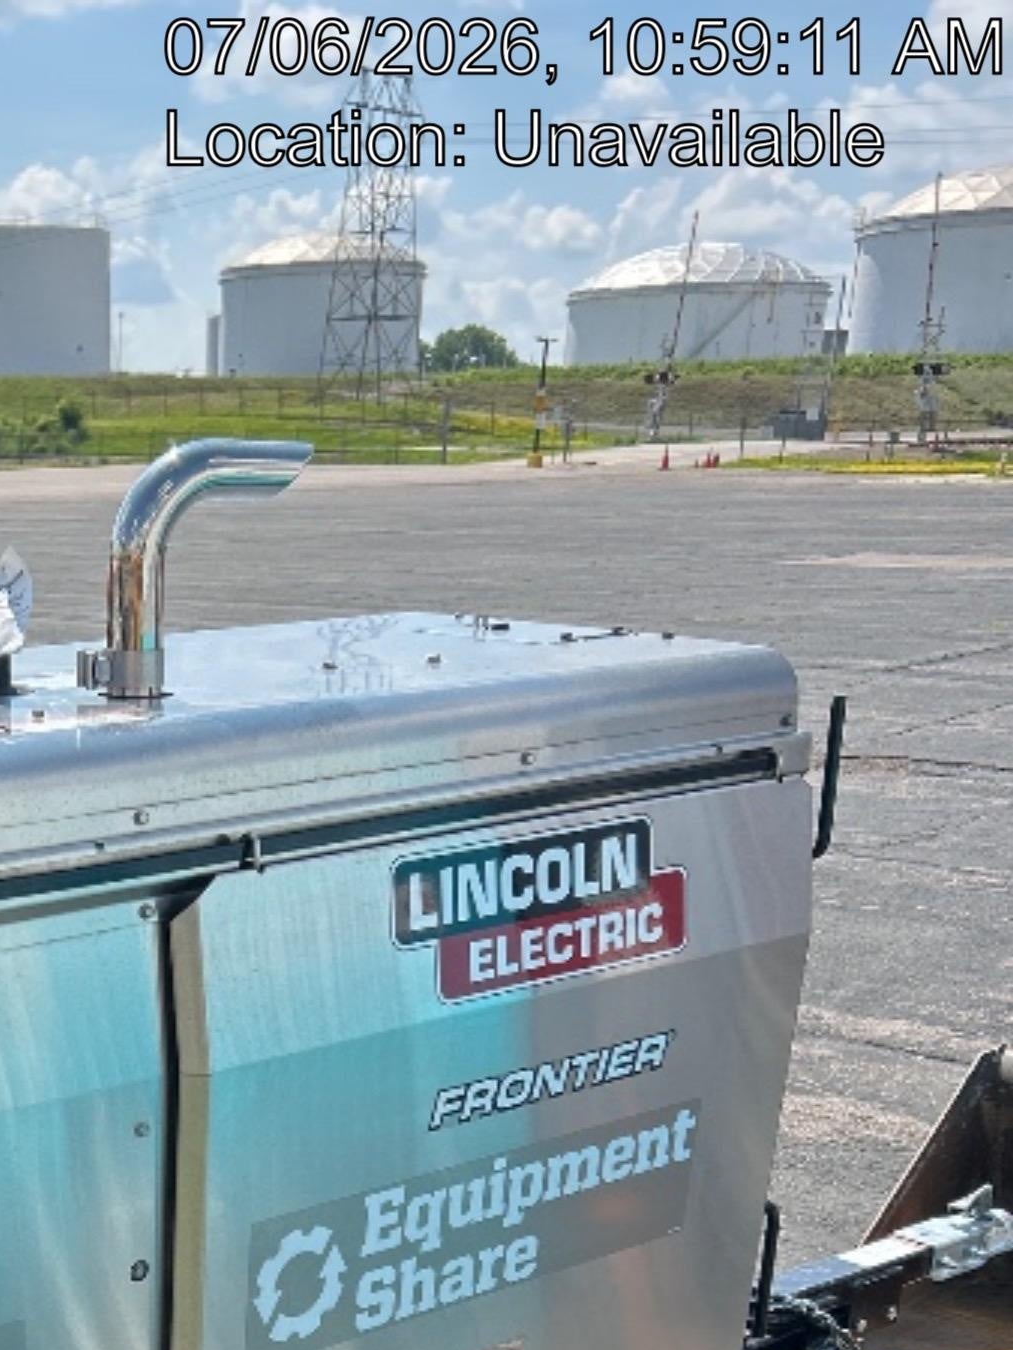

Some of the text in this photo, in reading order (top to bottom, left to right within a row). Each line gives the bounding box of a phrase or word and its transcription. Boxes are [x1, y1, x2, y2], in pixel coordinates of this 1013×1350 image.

[408, 833, 638, 932] LINCOLN
[468, 901, 664, 983] ELECTRIC
[428, 1031, 672, 1131] FRONTIER
[360, 1108, 696, 1258] Equipment
[354, 1234, 539, 1332] Share
